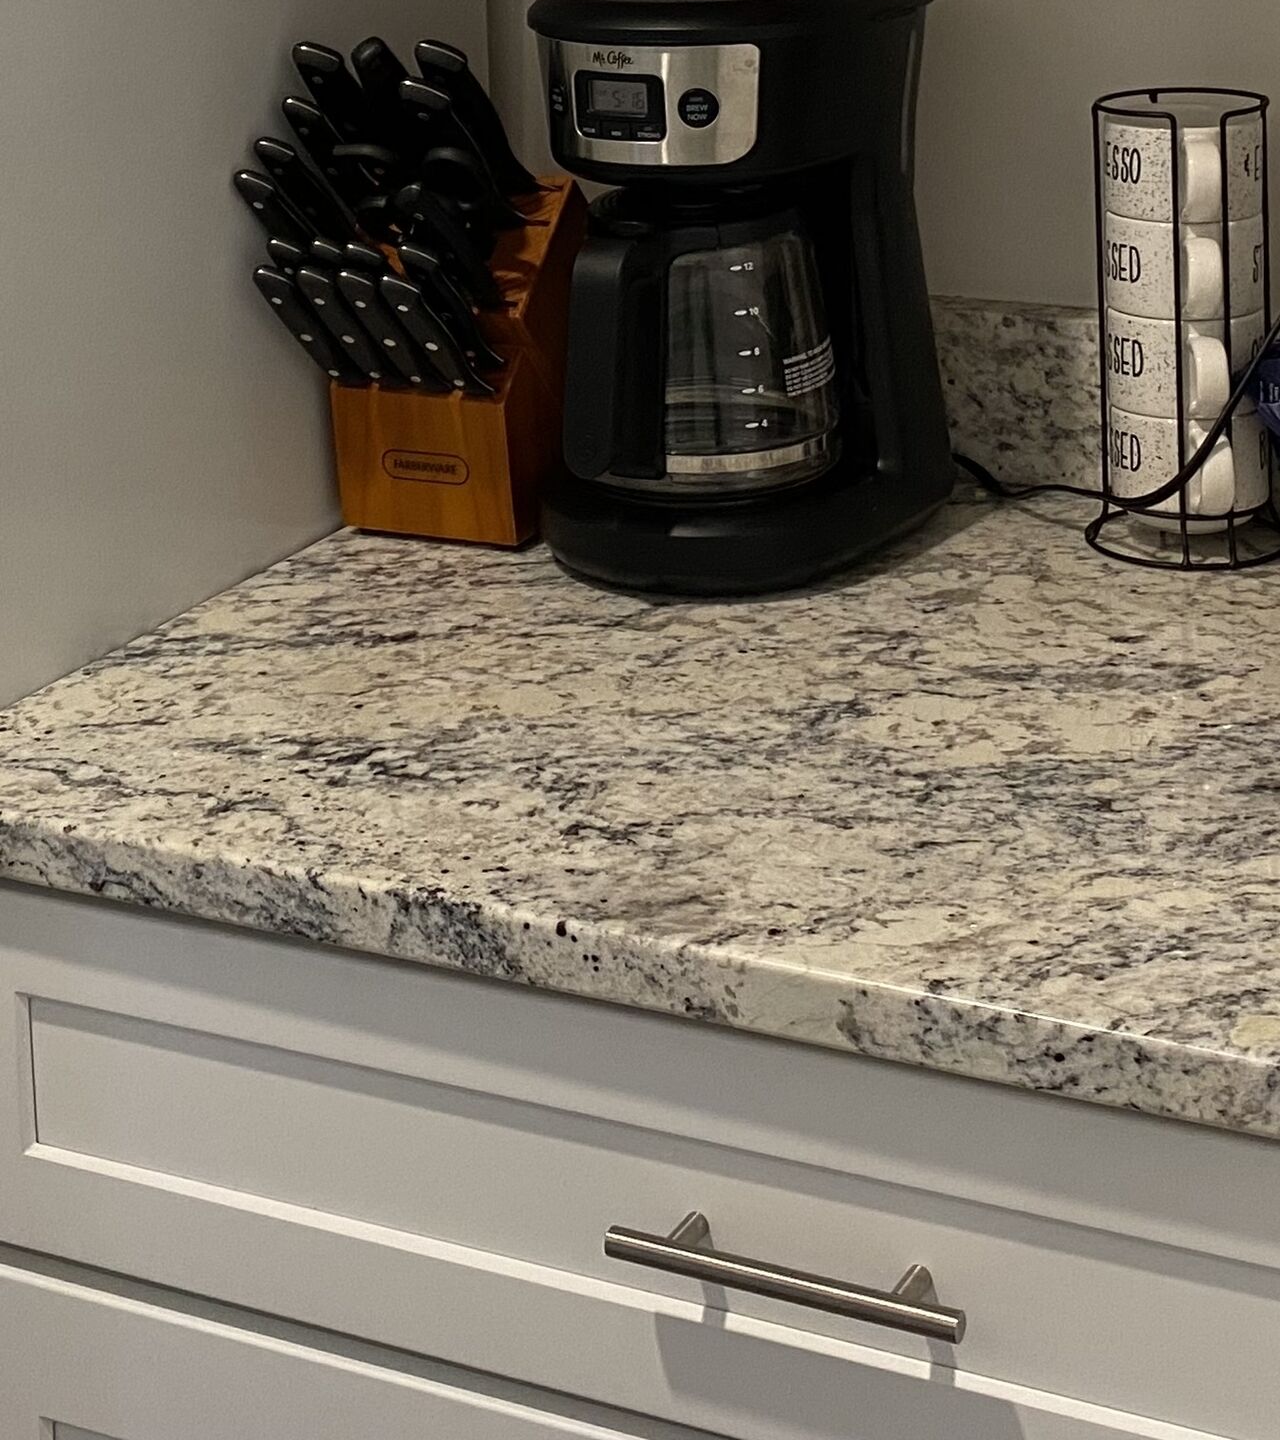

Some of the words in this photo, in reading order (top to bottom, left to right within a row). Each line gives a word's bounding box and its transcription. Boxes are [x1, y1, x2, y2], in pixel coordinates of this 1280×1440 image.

[607, 51, 634, 69] Coffee
[686, 104, 708, 112] BREW
[687, 113, 708, 121] NOW
[743, 262, 754, 271] 12
[749, 306, 759, 316] 10
[761, 418, 768, 428] 4
